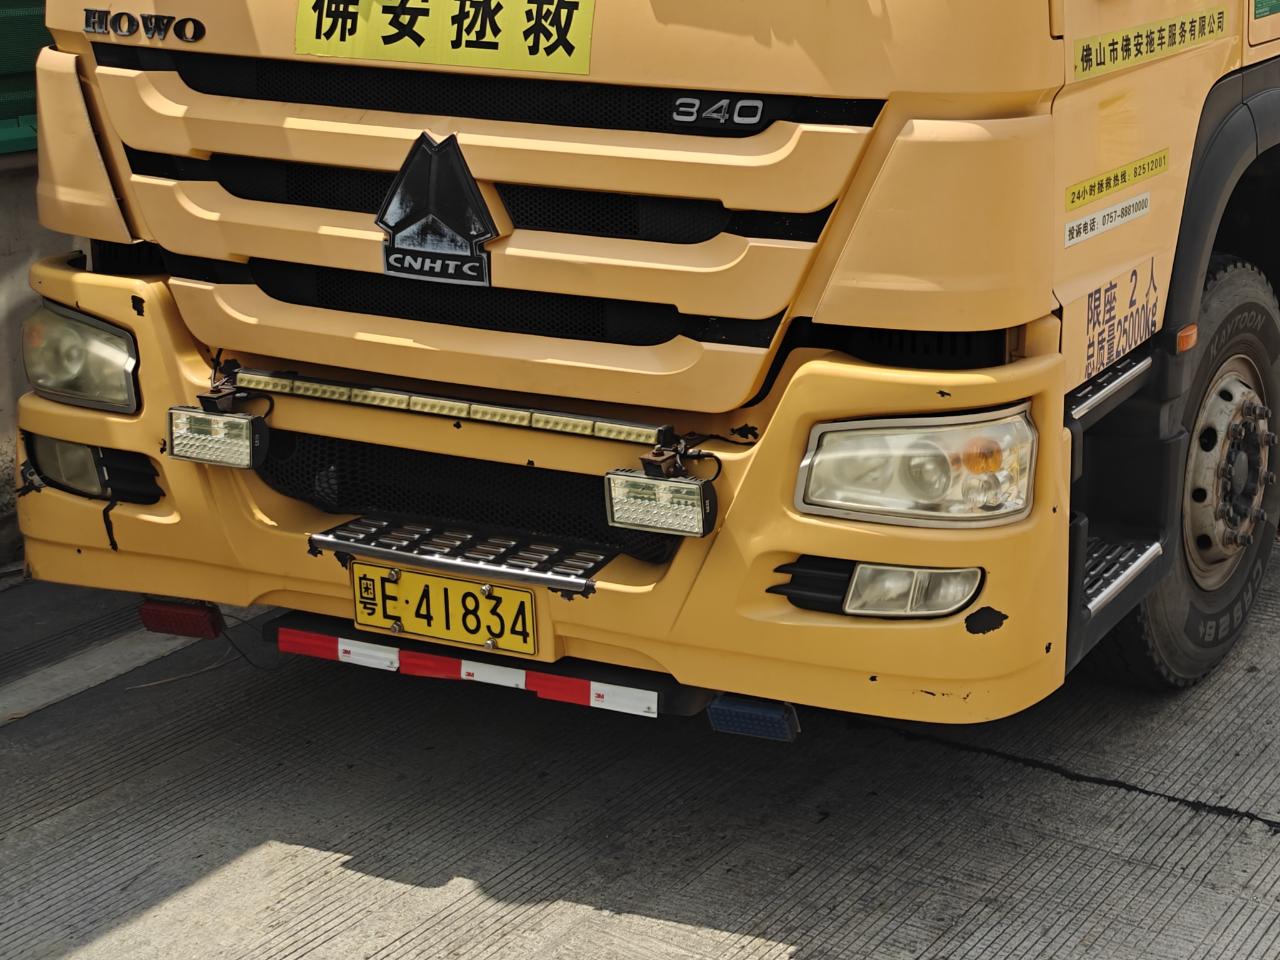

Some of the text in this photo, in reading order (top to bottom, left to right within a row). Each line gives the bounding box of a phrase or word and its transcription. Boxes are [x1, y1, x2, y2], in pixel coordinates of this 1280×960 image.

[83, 8, 207, 43] HOWO
[1080, 11, 1225, 72] 佛山市佛安拖车服务有限公司
[671, 97, 765, 126] 340
[388, 253, 480, 277] CNHTC
[341, 647, 352, 657] 3M
[464, 670, 475, 679] 3M
[594, 691, 605, 701] 3M
